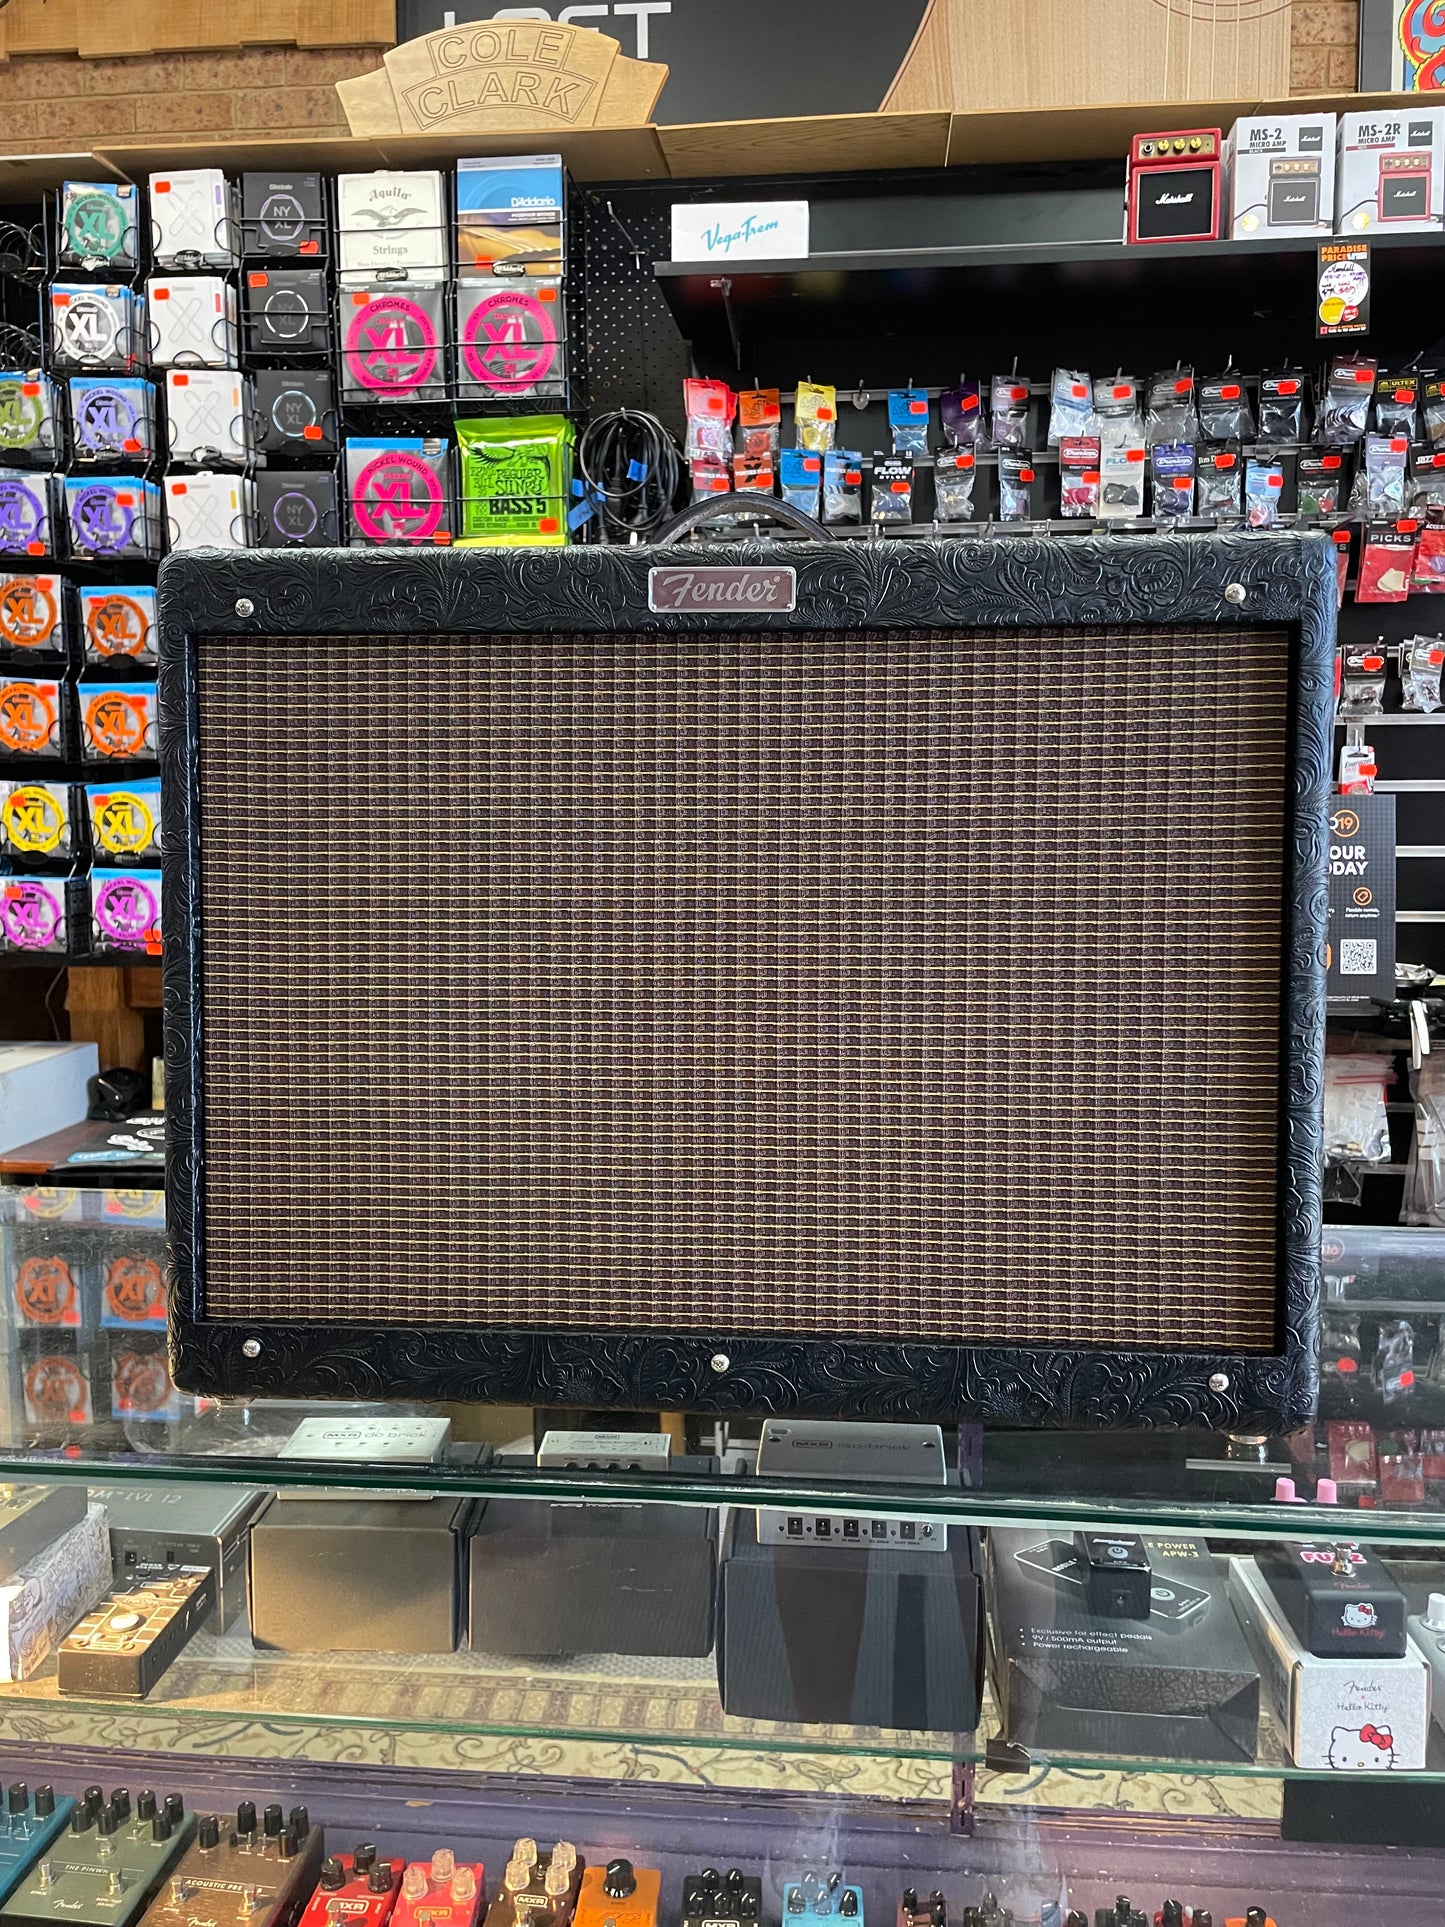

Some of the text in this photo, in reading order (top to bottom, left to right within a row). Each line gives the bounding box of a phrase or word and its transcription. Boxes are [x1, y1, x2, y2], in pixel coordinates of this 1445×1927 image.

[438, 29, 566, 70] COLE
[418, 71, 581, 119] CLARK
[1249, 128, 1282, 141] MS-2
[1358, 123, 1401, 138] MS-2R
[369, 187, 409, 202] Aquila
[273, 205, 292, 217] NY
[79, 211, 115, 240] XL
[373, 245, 409, 256] Strings
[1321, 244, 1368, 254] PARADISE
[1321, 253, 1348, 262] PRICE
[369, 301, 411, 313] CHROMES
[488, 296, 529, 308] CHROMES
[69, 312, 108, 341] XL
[364, 328, 421, 366] XL
[482, 323, 538, 361] XL
[285, 403, 303, 413] NY
[88, 406, 125, 433] XL
[287, 414, 304, 425] XL
[367, 456, 429, 475] NICKEL WOUND
[874, 466, 912, 475] FLOW
[371, 482, 427, 518] XL
[489, 498, 547, 516] BASS 5
[83, 506, 122, 533] XL
[1370, 534, 1412, 544] PICKS
[663, 573, 781, 607] Fender
[7, 598, 45, 625] XL
[100, 613, 138, 640] XL
[4, 703, 43, 731] XL
[99, 711, 137, 737] XL
[14, 806, 53, 833] XL
[104, 811, 143, 836] XL
[1329, 845, 1366, 860] OUR
[1329, 861, 1369, 876] DAY
[11, 901, 49, 928] XL
[108, 896, 146, 923] XL
[161, 1494, 182, 1504] 12
[1157, 1542, 1197, 1550] POWER
[1162, 1550, 1199, 1558] APW-3
[1300, 1551, 1368, 1564] FUZ
[1031, 1627, 1072, 1636] Exclusive
[1332, 1628, 1388, 1639] Hello Kitty
[1033, 1641, 1129, 1653] Power rechargeable
[1051, 1635, 1085, 1643] 500mA
[1086, 1637, 1117, 1645] output
[1343, 1680, 1383, 1693] Fender
[1337, 1702, 1390, 1713] Hello Kitty
[185, 1879, 263, 1894] ACOUSTIC PREB
[53, 1899, 84, 1910] Fender
[186, 1916, 218, 1927] Fender
